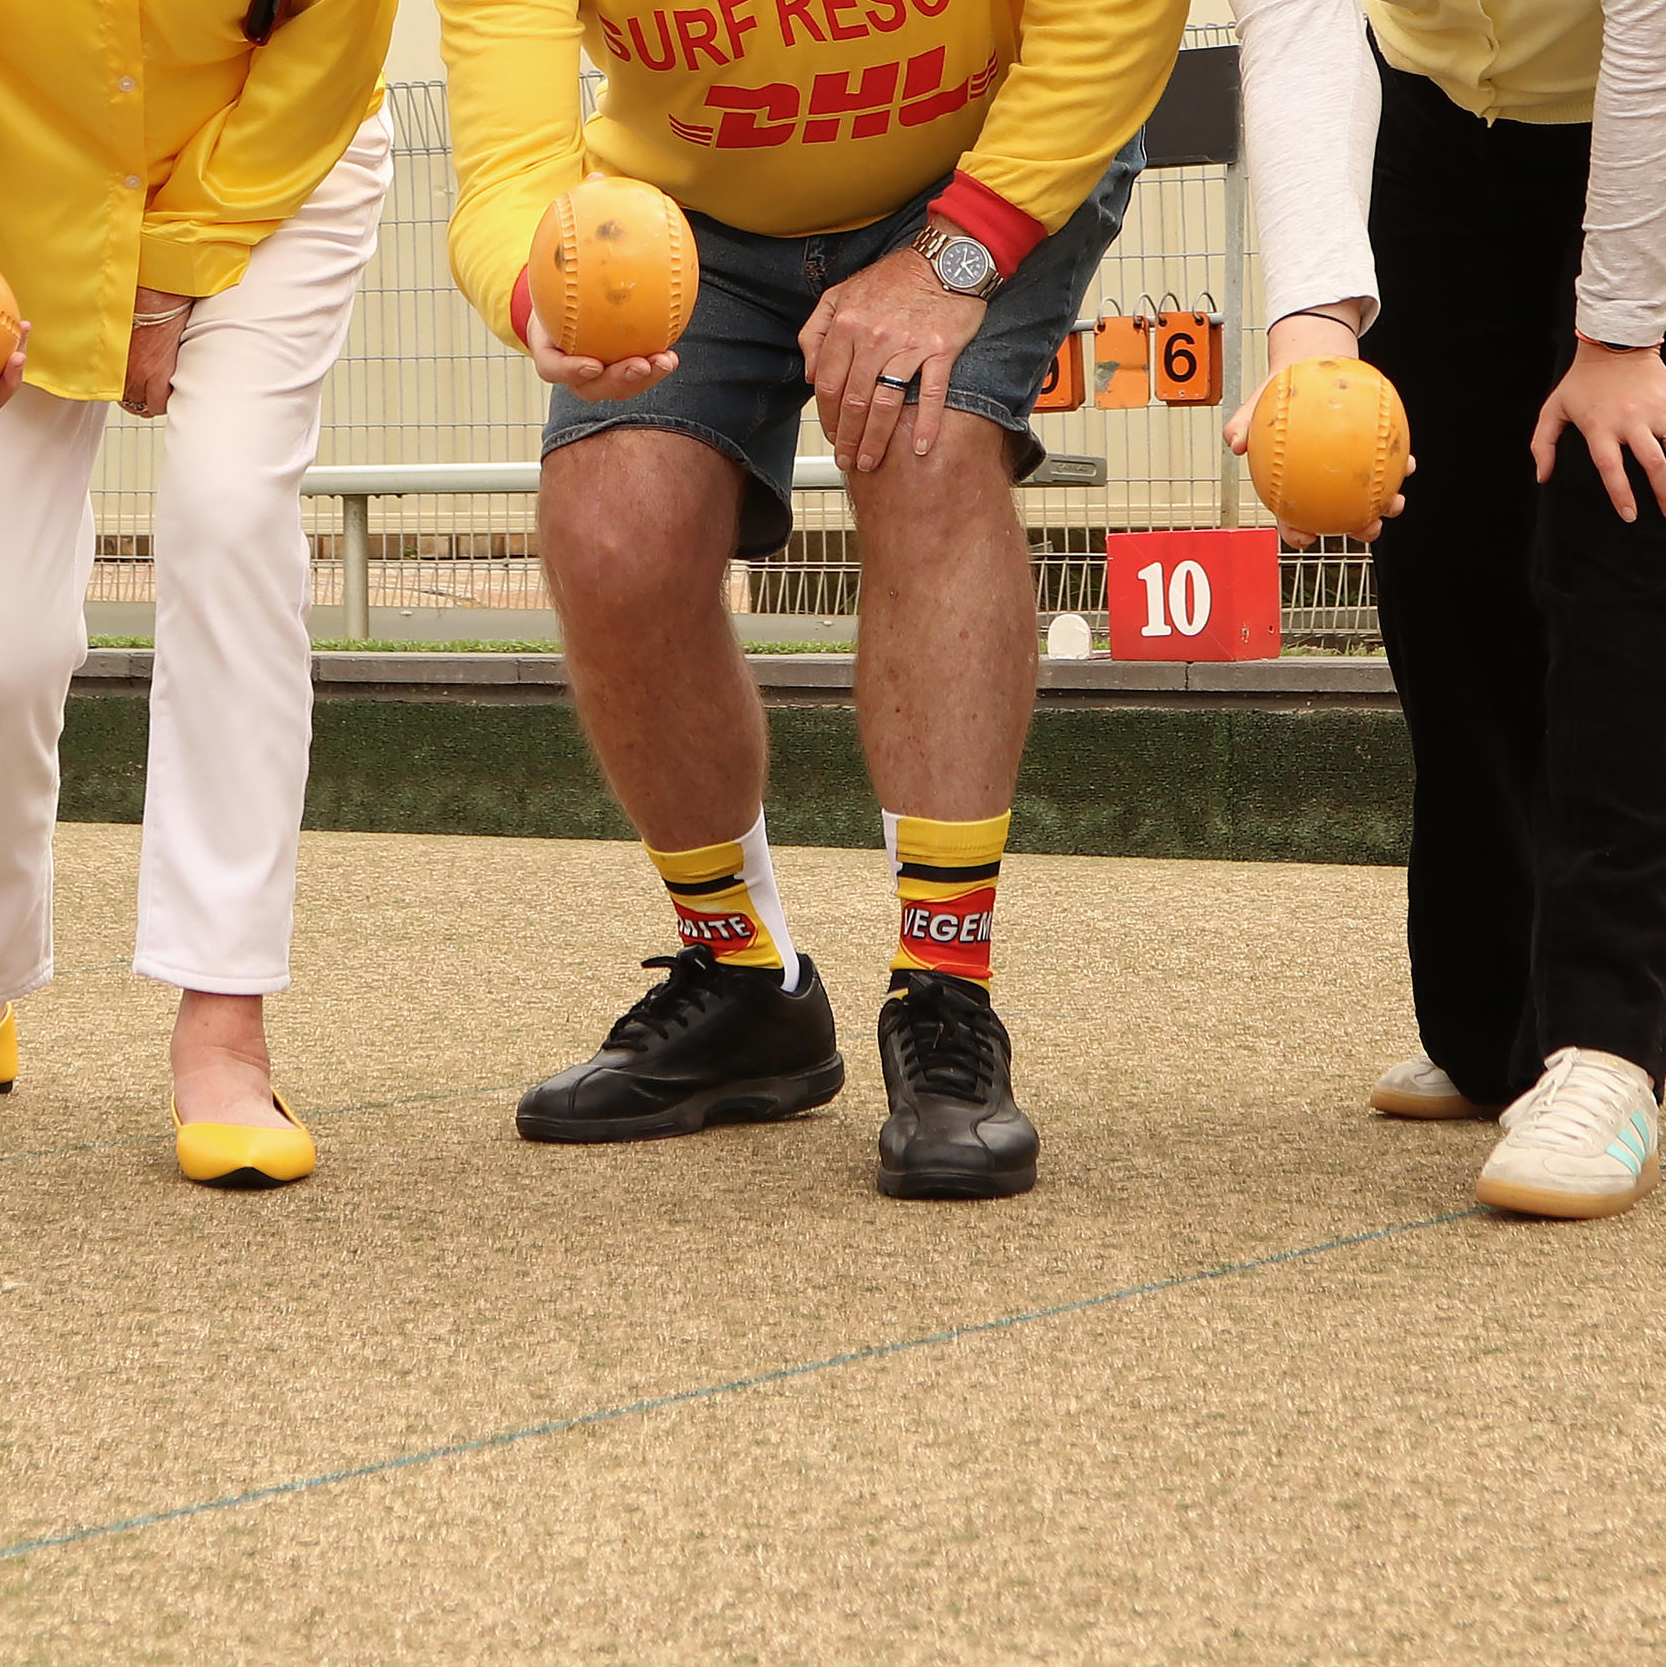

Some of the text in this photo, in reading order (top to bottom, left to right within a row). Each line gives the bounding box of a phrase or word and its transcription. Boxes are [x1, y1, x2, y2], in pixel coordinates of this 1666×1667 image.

[704, 45, 970, 149] DHL
[1164, 332, 1197, 383] 6
[1137, 560, 1212, 637] 10
